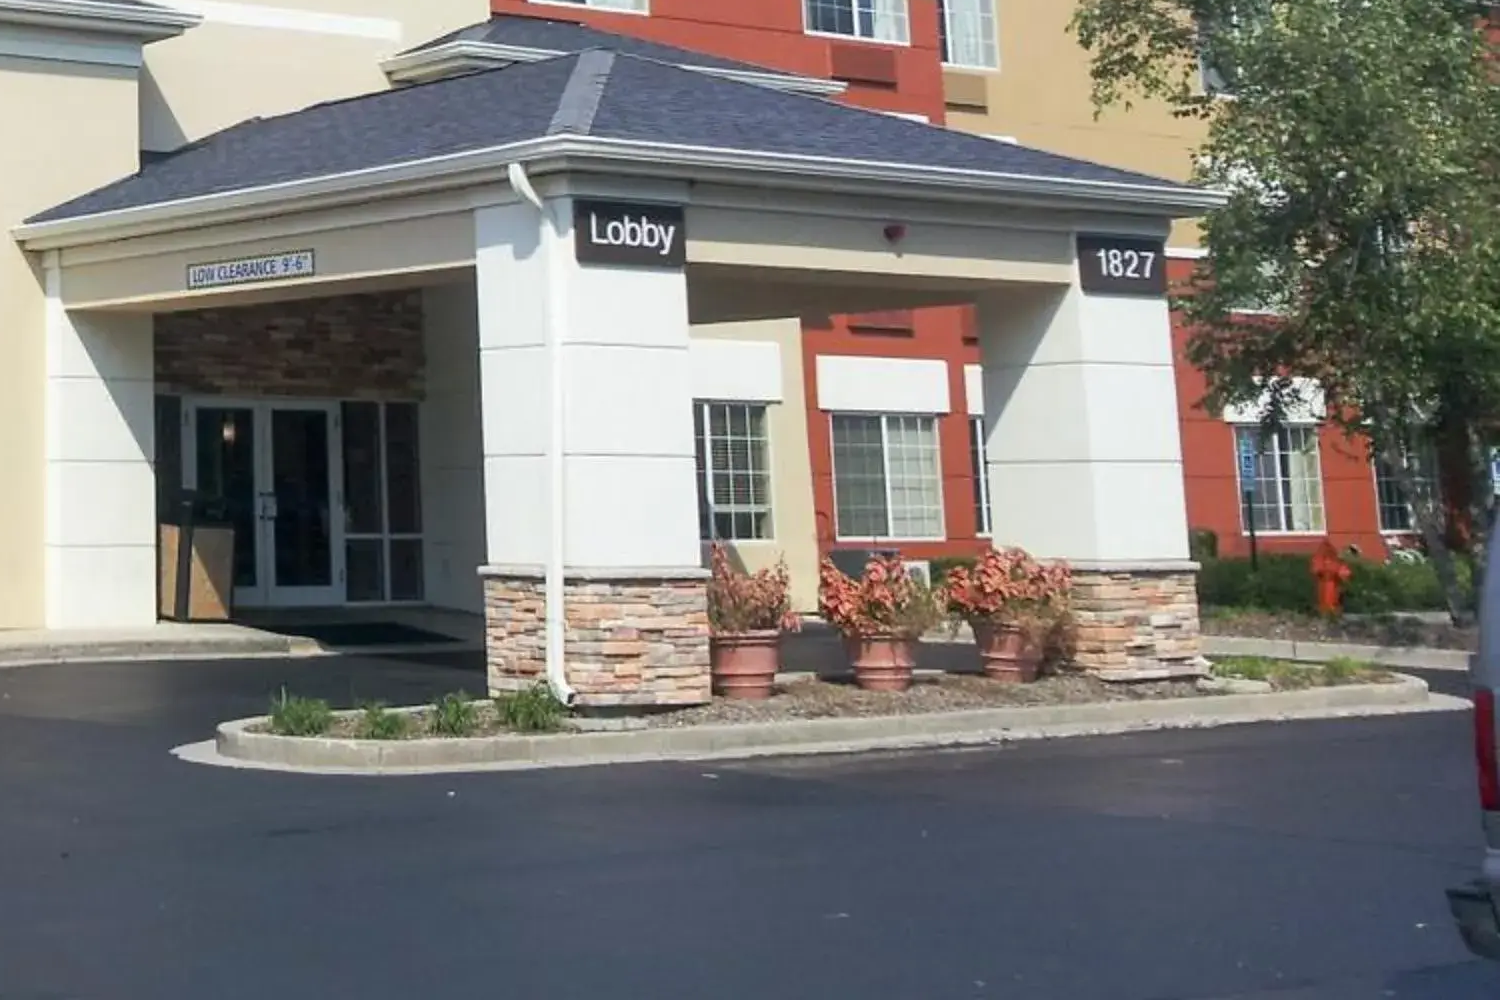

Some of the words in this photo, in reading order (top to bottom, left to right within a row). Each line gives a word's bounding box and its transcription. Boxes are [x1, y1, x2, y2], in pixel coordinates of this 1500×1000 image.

[590, 211, 676, 255] Lobby
[192, 267, 215, 283] LOW
[217, 259, 277, 281] CLEARANCE
[1096, 248, 1156, 278] 1827
